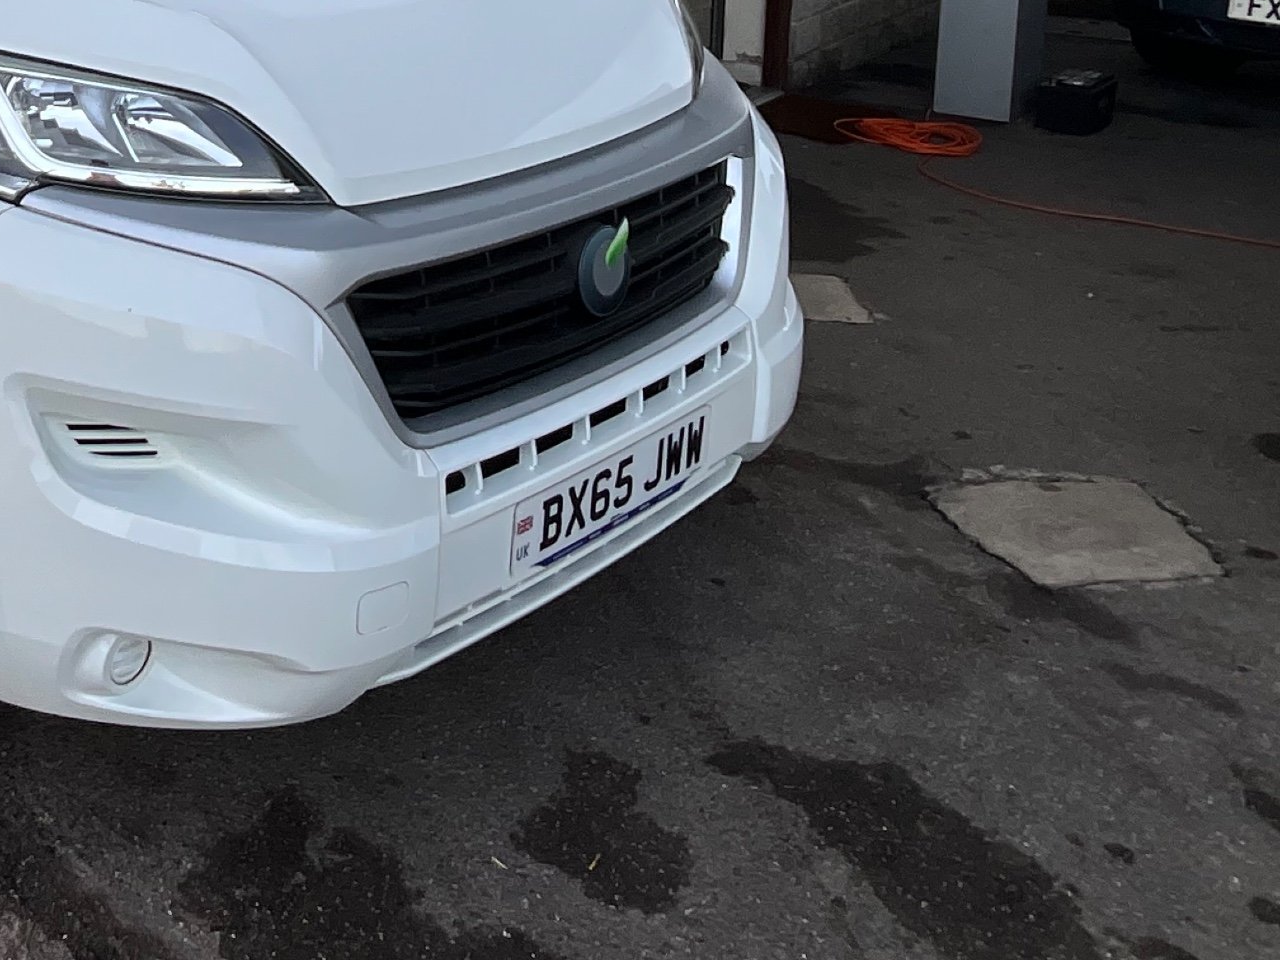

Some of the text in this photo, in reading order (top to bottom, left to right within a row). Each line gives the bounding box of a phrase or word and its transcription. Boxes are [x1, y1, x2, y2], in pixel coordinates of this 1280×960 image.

[539, 415, 705, 552] BX65 JWW
[516, 542, 530, 562] UK
